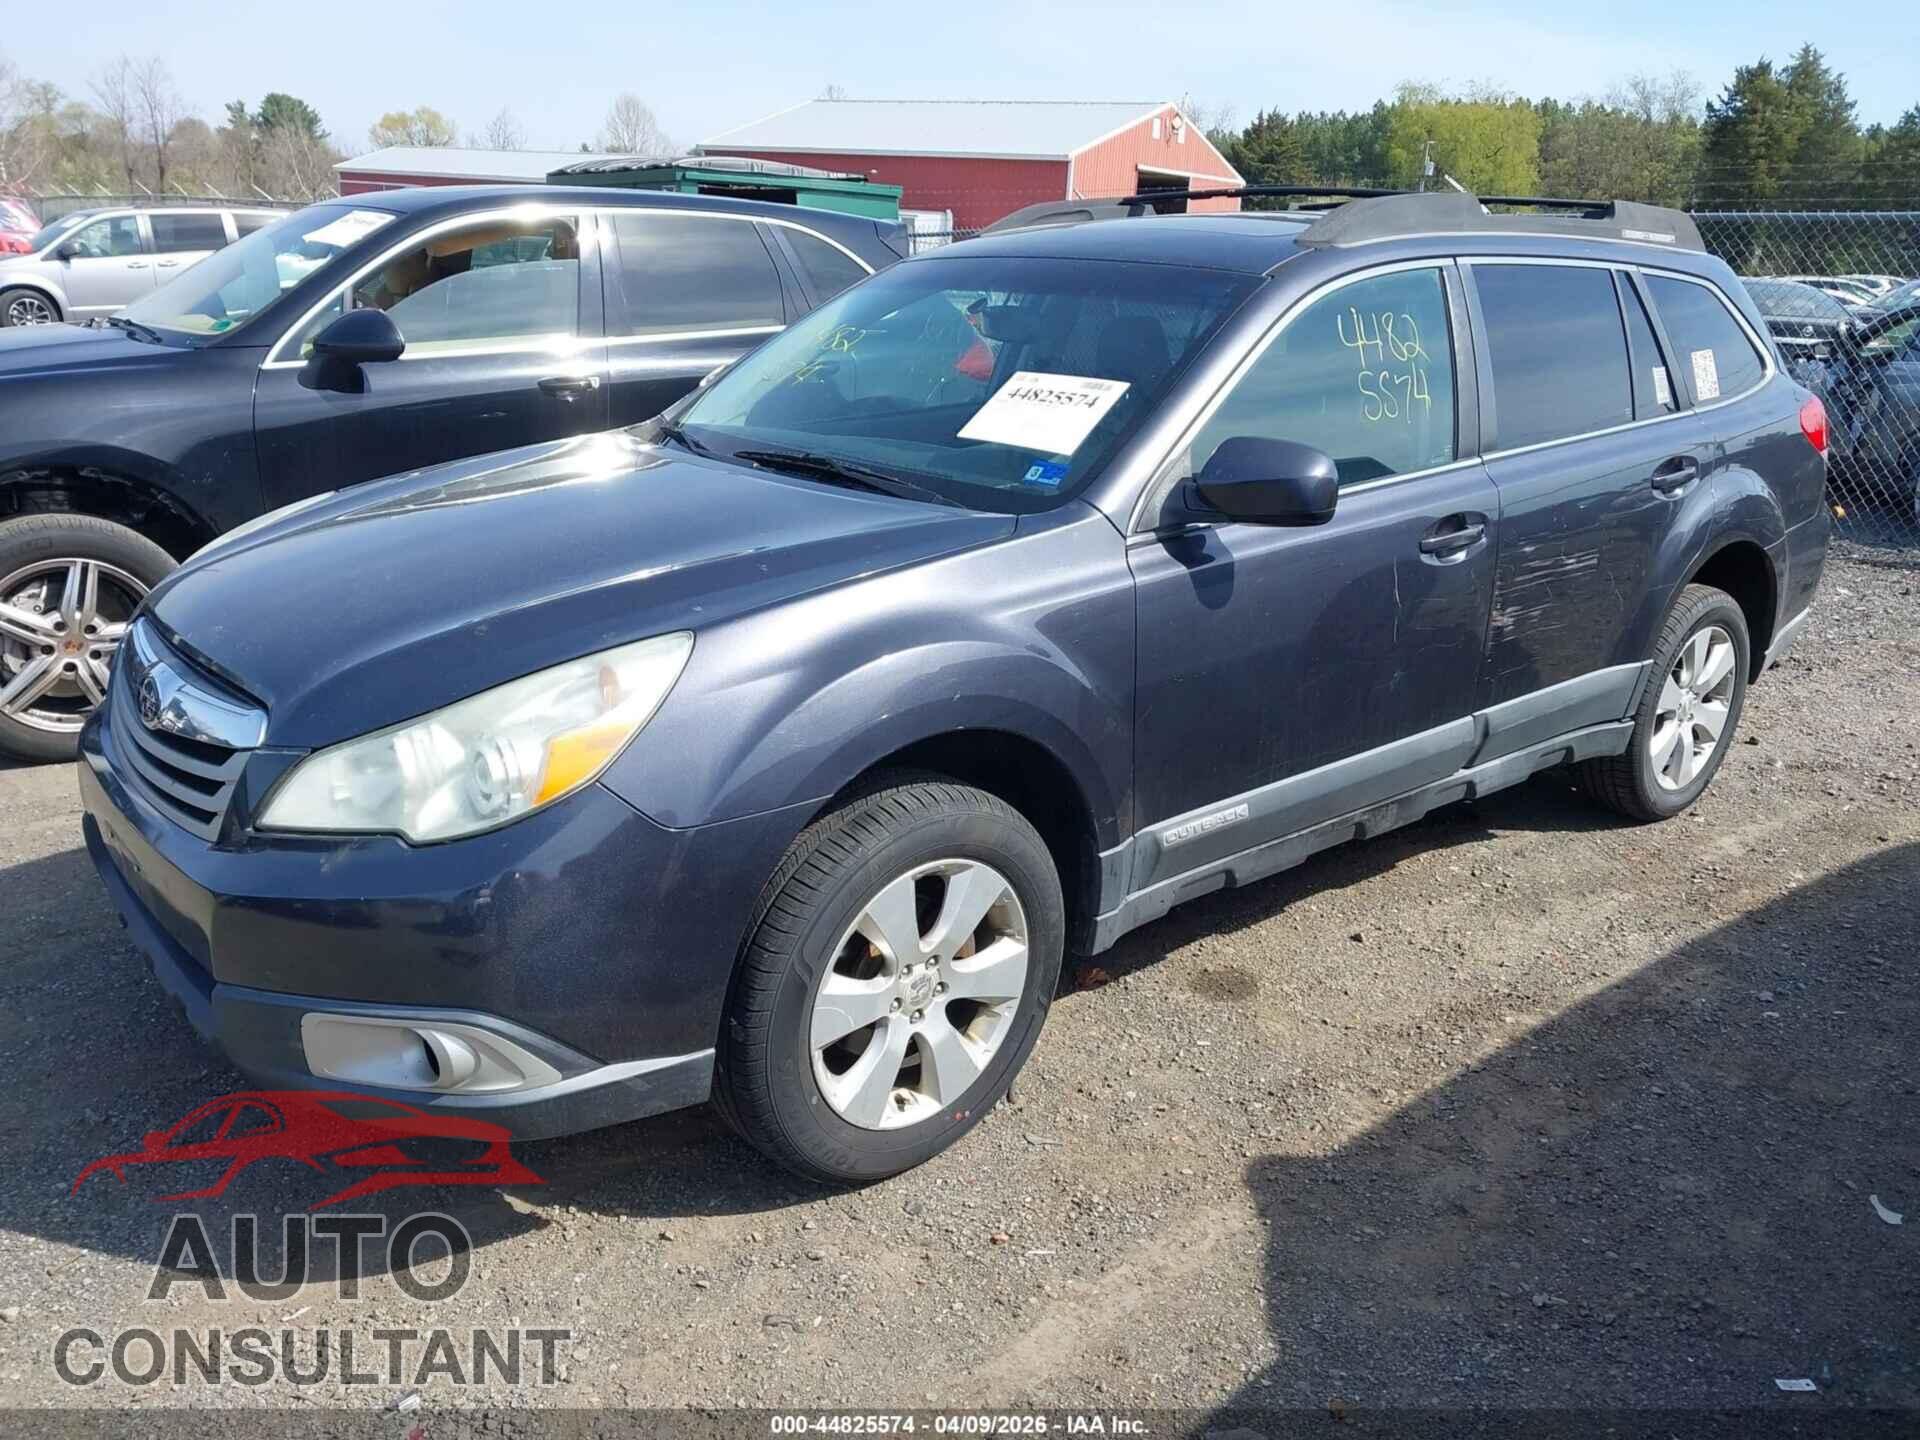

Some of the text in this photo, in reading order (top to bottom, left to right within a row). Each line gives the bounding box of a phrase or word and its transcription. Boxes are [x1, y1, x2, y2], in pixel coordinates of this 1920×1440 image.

[1337, 307, 1432, 369] 4482
[1008, 386, 1100, 409] 44825574
[1164, 803, 1249, 846] OUTBACK
